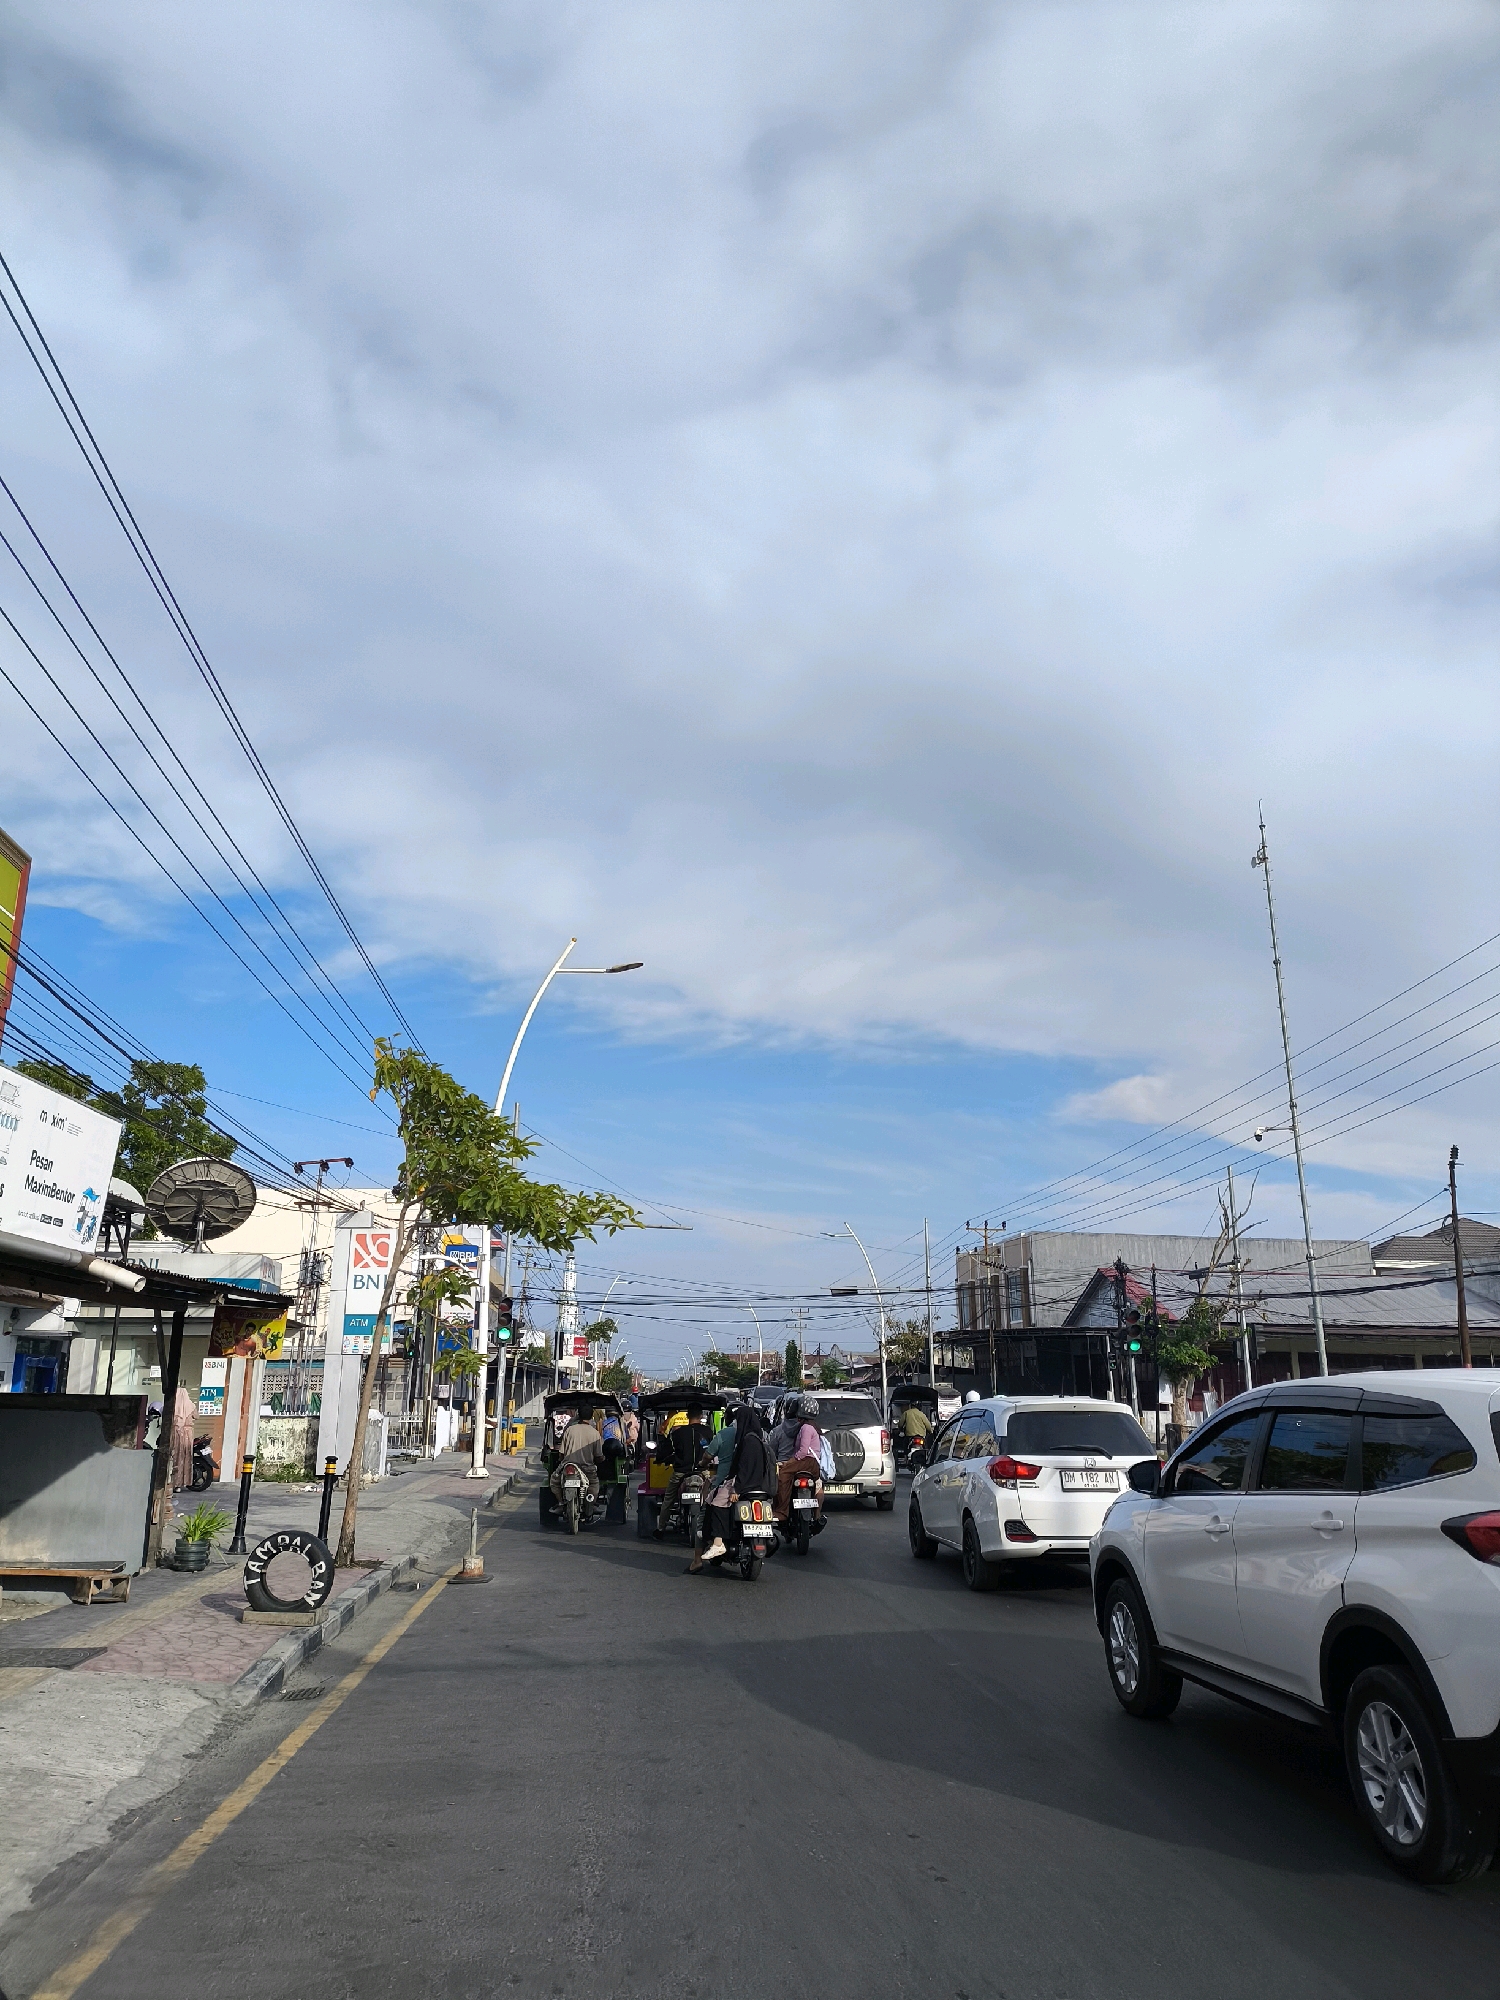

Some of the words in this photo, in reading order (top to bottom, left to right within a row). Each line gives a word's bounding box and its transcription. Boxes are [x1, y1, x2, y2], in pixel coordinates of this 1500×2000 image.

[29, 1149, 54, 1173] Pesan
[24, 1173, 76, 1204] MaximBentor
[349, 1318, 369, 1327] ATM
[211, 1361, 225, 1369] BNI
[199, 1388, 217, 1397] ATM
[1064, 1472, 1076, 1483] DM
[1079, 1472, 1100, 1483] 1182
[243, 1534, 313, 1591] TAMPAL
[303, 1560, 327, 1608] BAN
